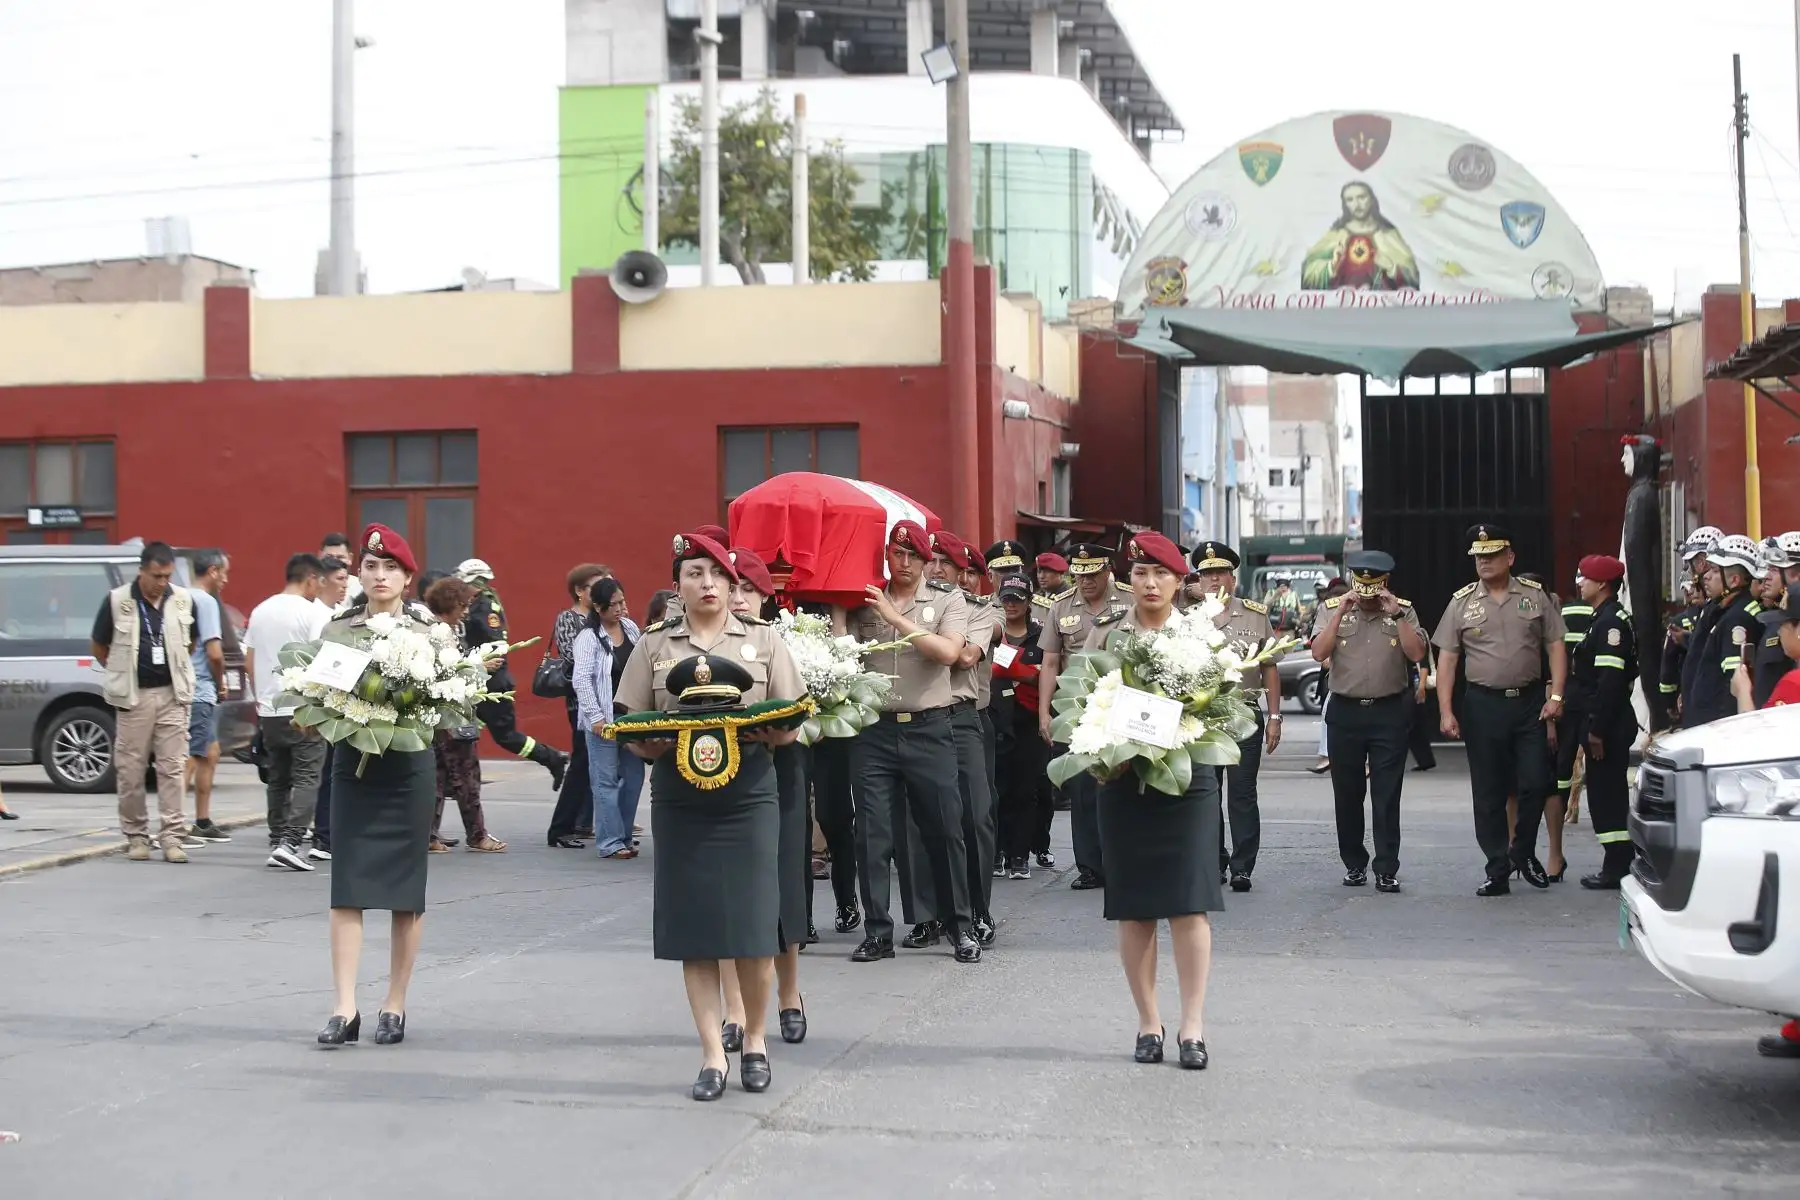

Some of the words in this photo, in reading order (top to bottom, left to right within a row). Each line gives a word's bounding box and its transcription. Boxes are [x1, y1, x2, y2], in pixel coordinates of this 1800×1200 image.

[1285, 293, 1326, 310] con
[1335, 285, 1389, 309] Dios
[1266, 570, 1325, 580] PICIA
